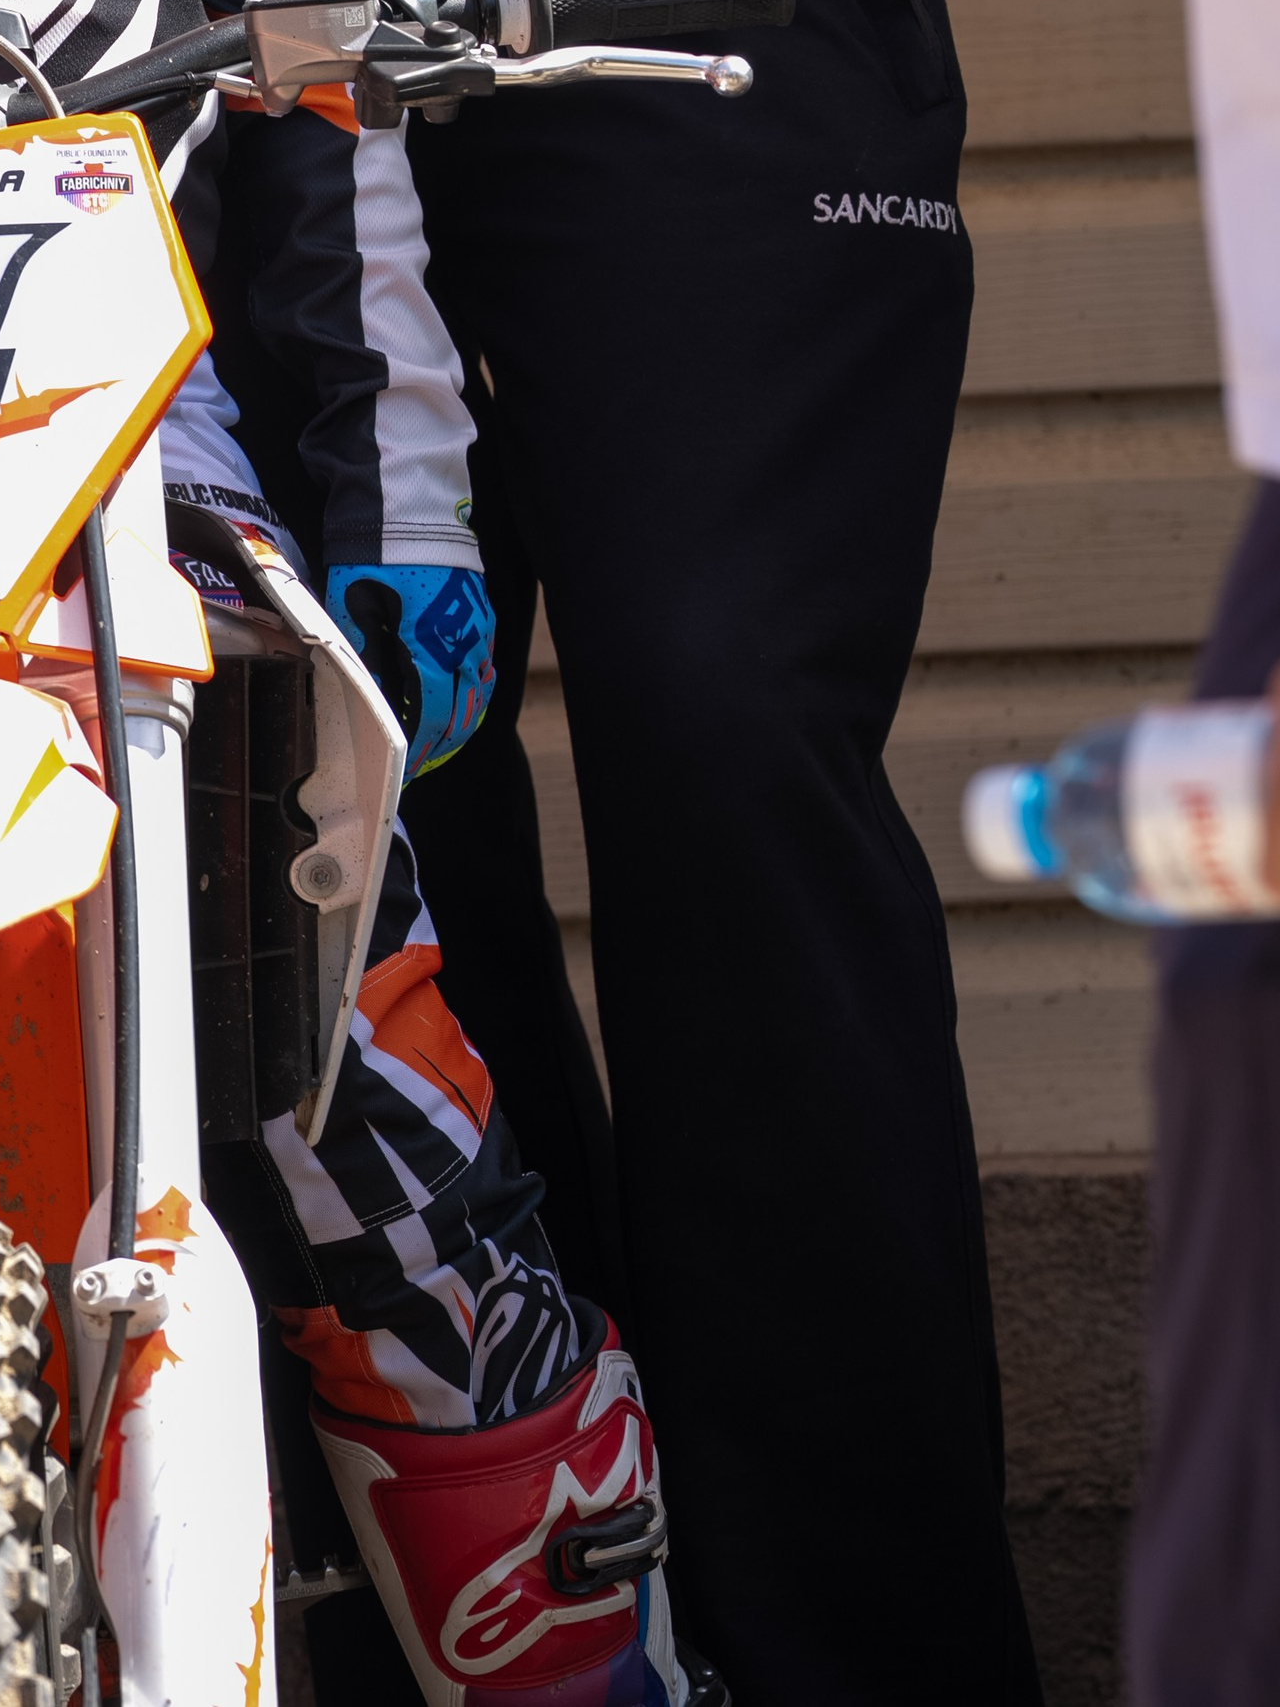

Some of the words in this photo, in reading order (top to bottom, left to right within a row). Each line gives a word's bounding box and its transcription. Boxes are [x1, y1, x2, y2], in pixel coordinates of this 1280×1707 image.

[56, 149, 81, 157] PUBLIC
[83, 149, 128, 157] FOUNDATION
[62, 177, 126, 191] FABRICHNIY
